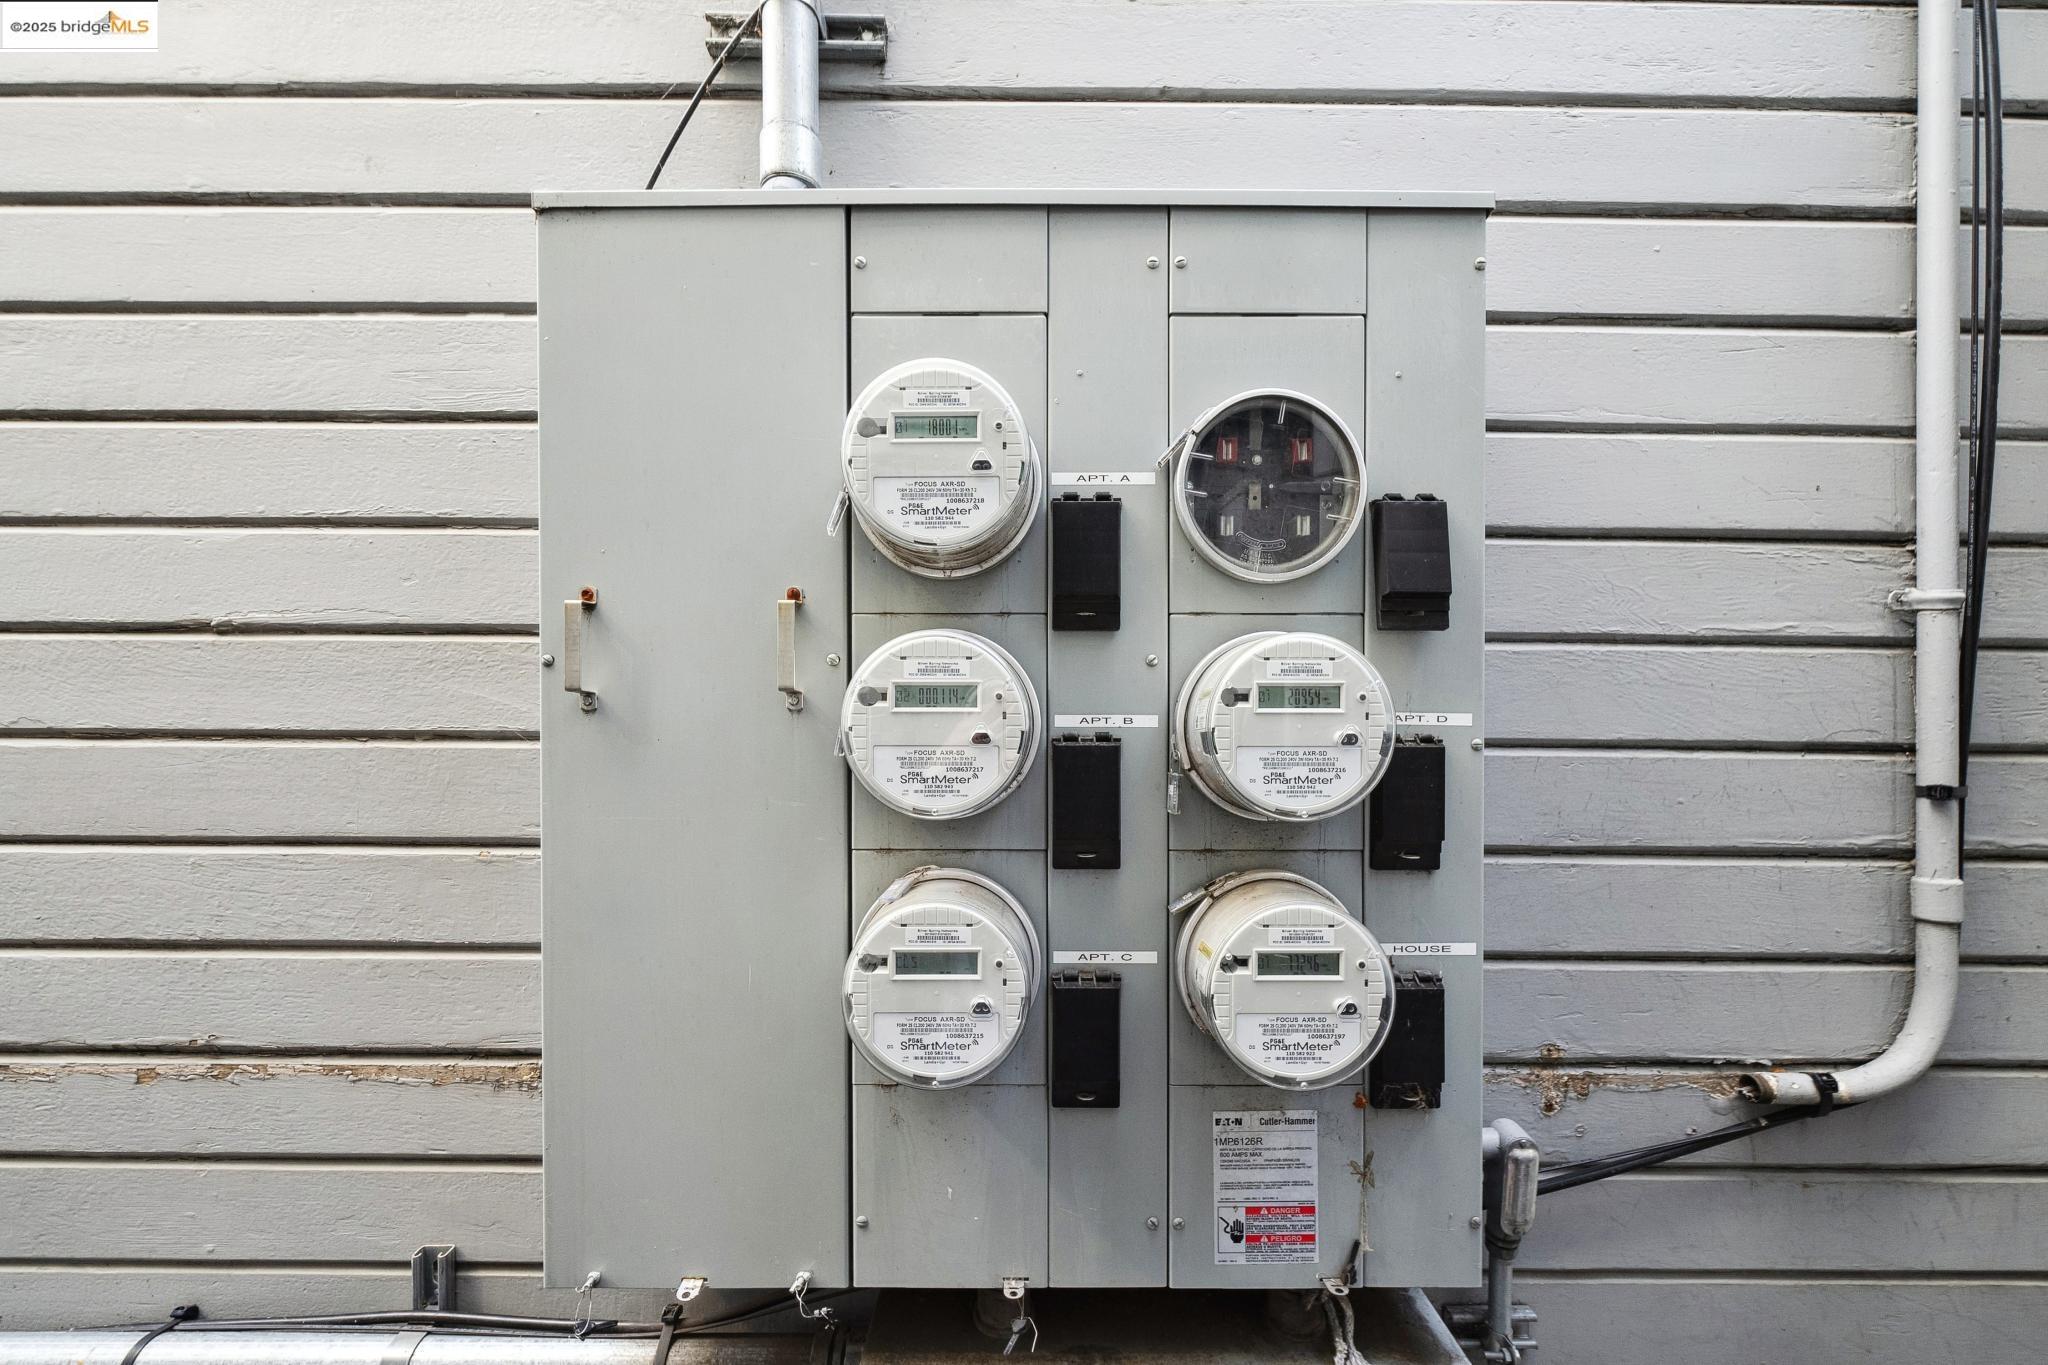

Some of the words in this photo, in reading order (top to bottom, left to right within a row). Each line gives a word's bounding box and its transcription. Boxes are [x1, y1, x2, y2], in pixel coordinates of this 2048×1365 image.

[901, 506, 972, 515] SmartMeter
[900, 775, 972, 784] SmartMeter
[1263, 776, 1334, 784] SmartMeter
[900, 1041, 972, 1051] SmartMeter
[1262, 1042, 1333, 1051] SmartMeter
[1260, 1117, 1315, 1126] Cutler-Hammer
